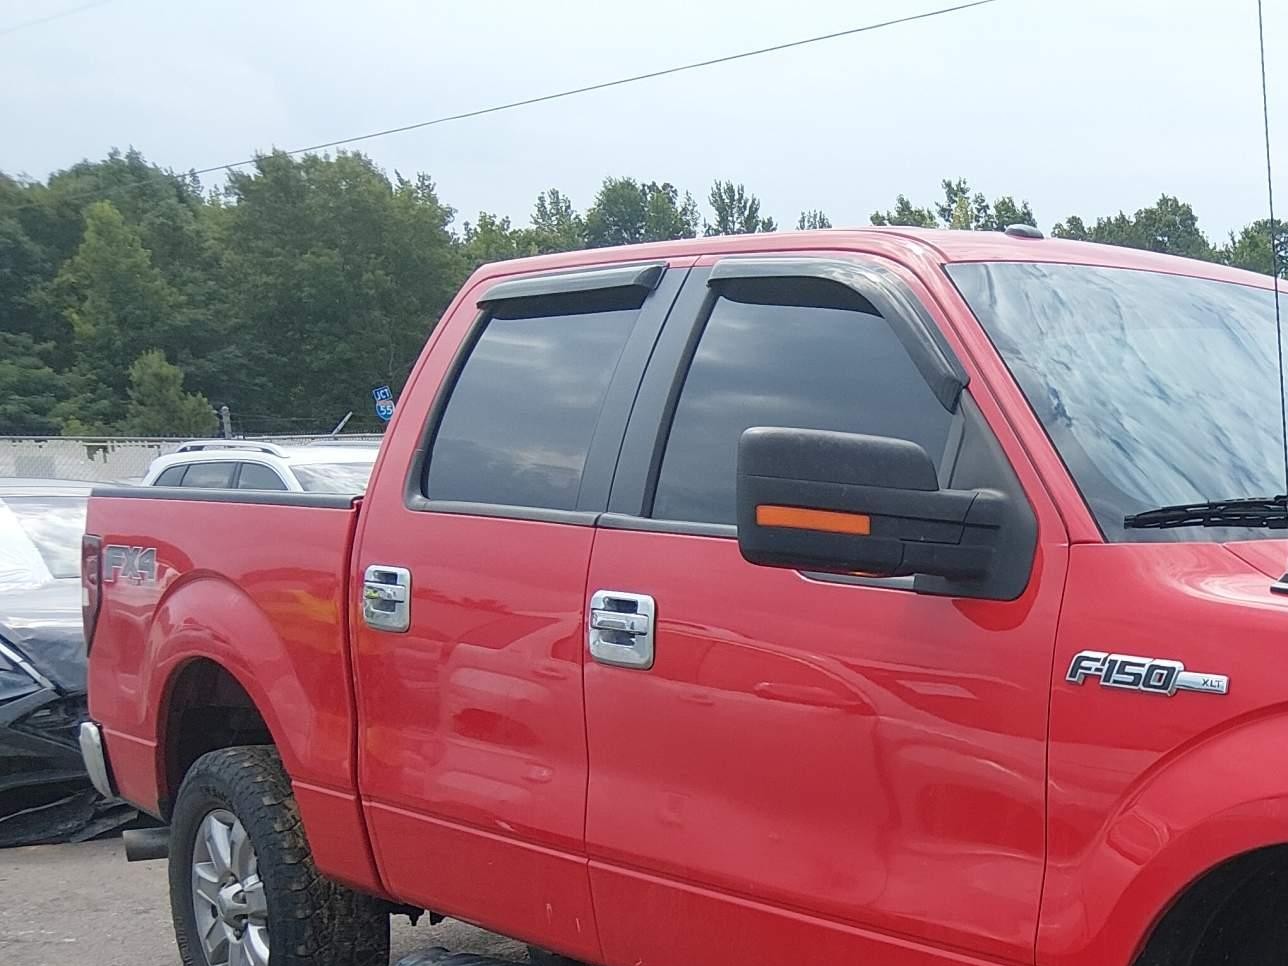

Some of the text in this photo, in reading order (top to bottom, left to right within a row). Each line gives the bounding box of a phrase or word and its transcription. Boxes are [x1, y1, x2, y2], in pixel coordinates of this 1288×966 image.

[376, 389, 390, 400] JCT
[380, 405, 393, 416] 55
[102, 543, 157, 583] FX4
[1201, 677, 1224, 689] XLT
